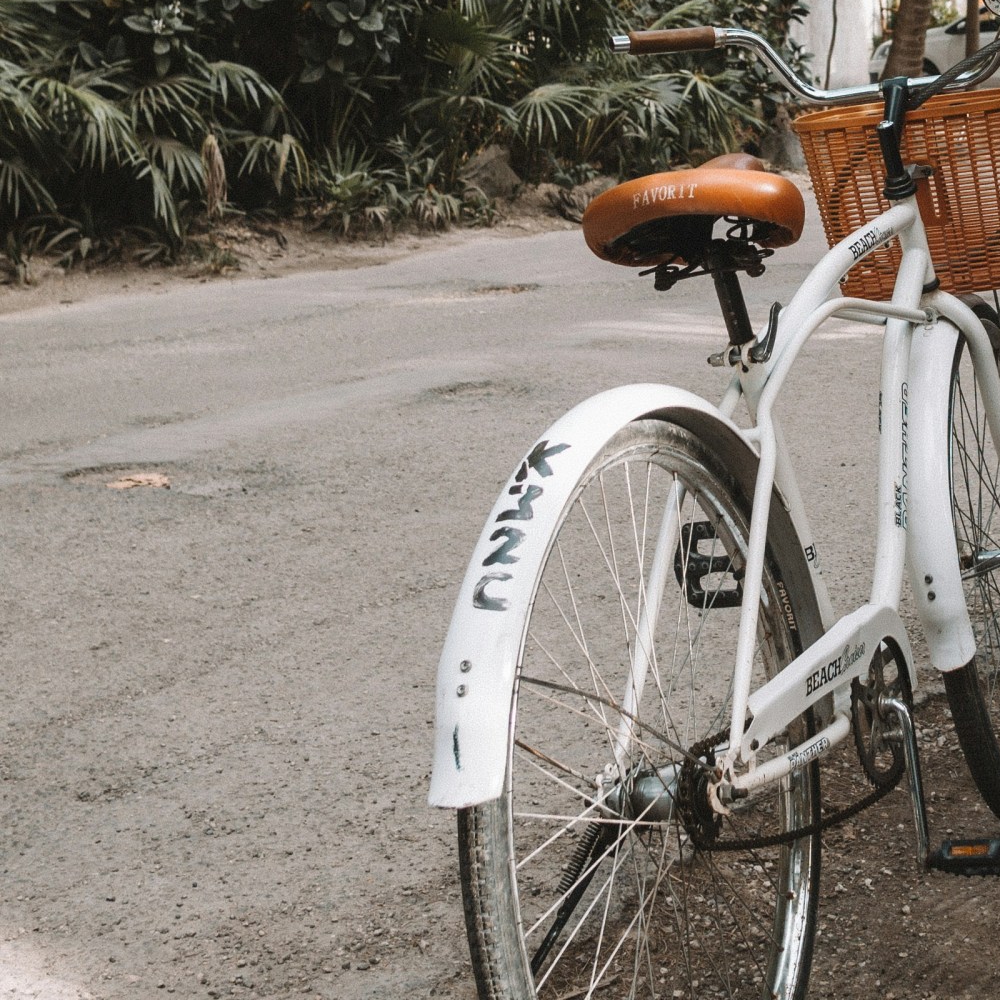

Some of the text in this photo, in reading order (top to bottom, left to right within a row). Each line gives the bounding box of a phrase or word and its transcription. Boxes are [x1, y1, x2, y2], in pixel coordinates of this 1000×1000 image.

[632, 183, 698, 210] FAVORIT
[848, 230, 878, 261] BEACH
[776, 581, 797, 631] FAVORIT
[805, 656, 842, 697] BEACH
